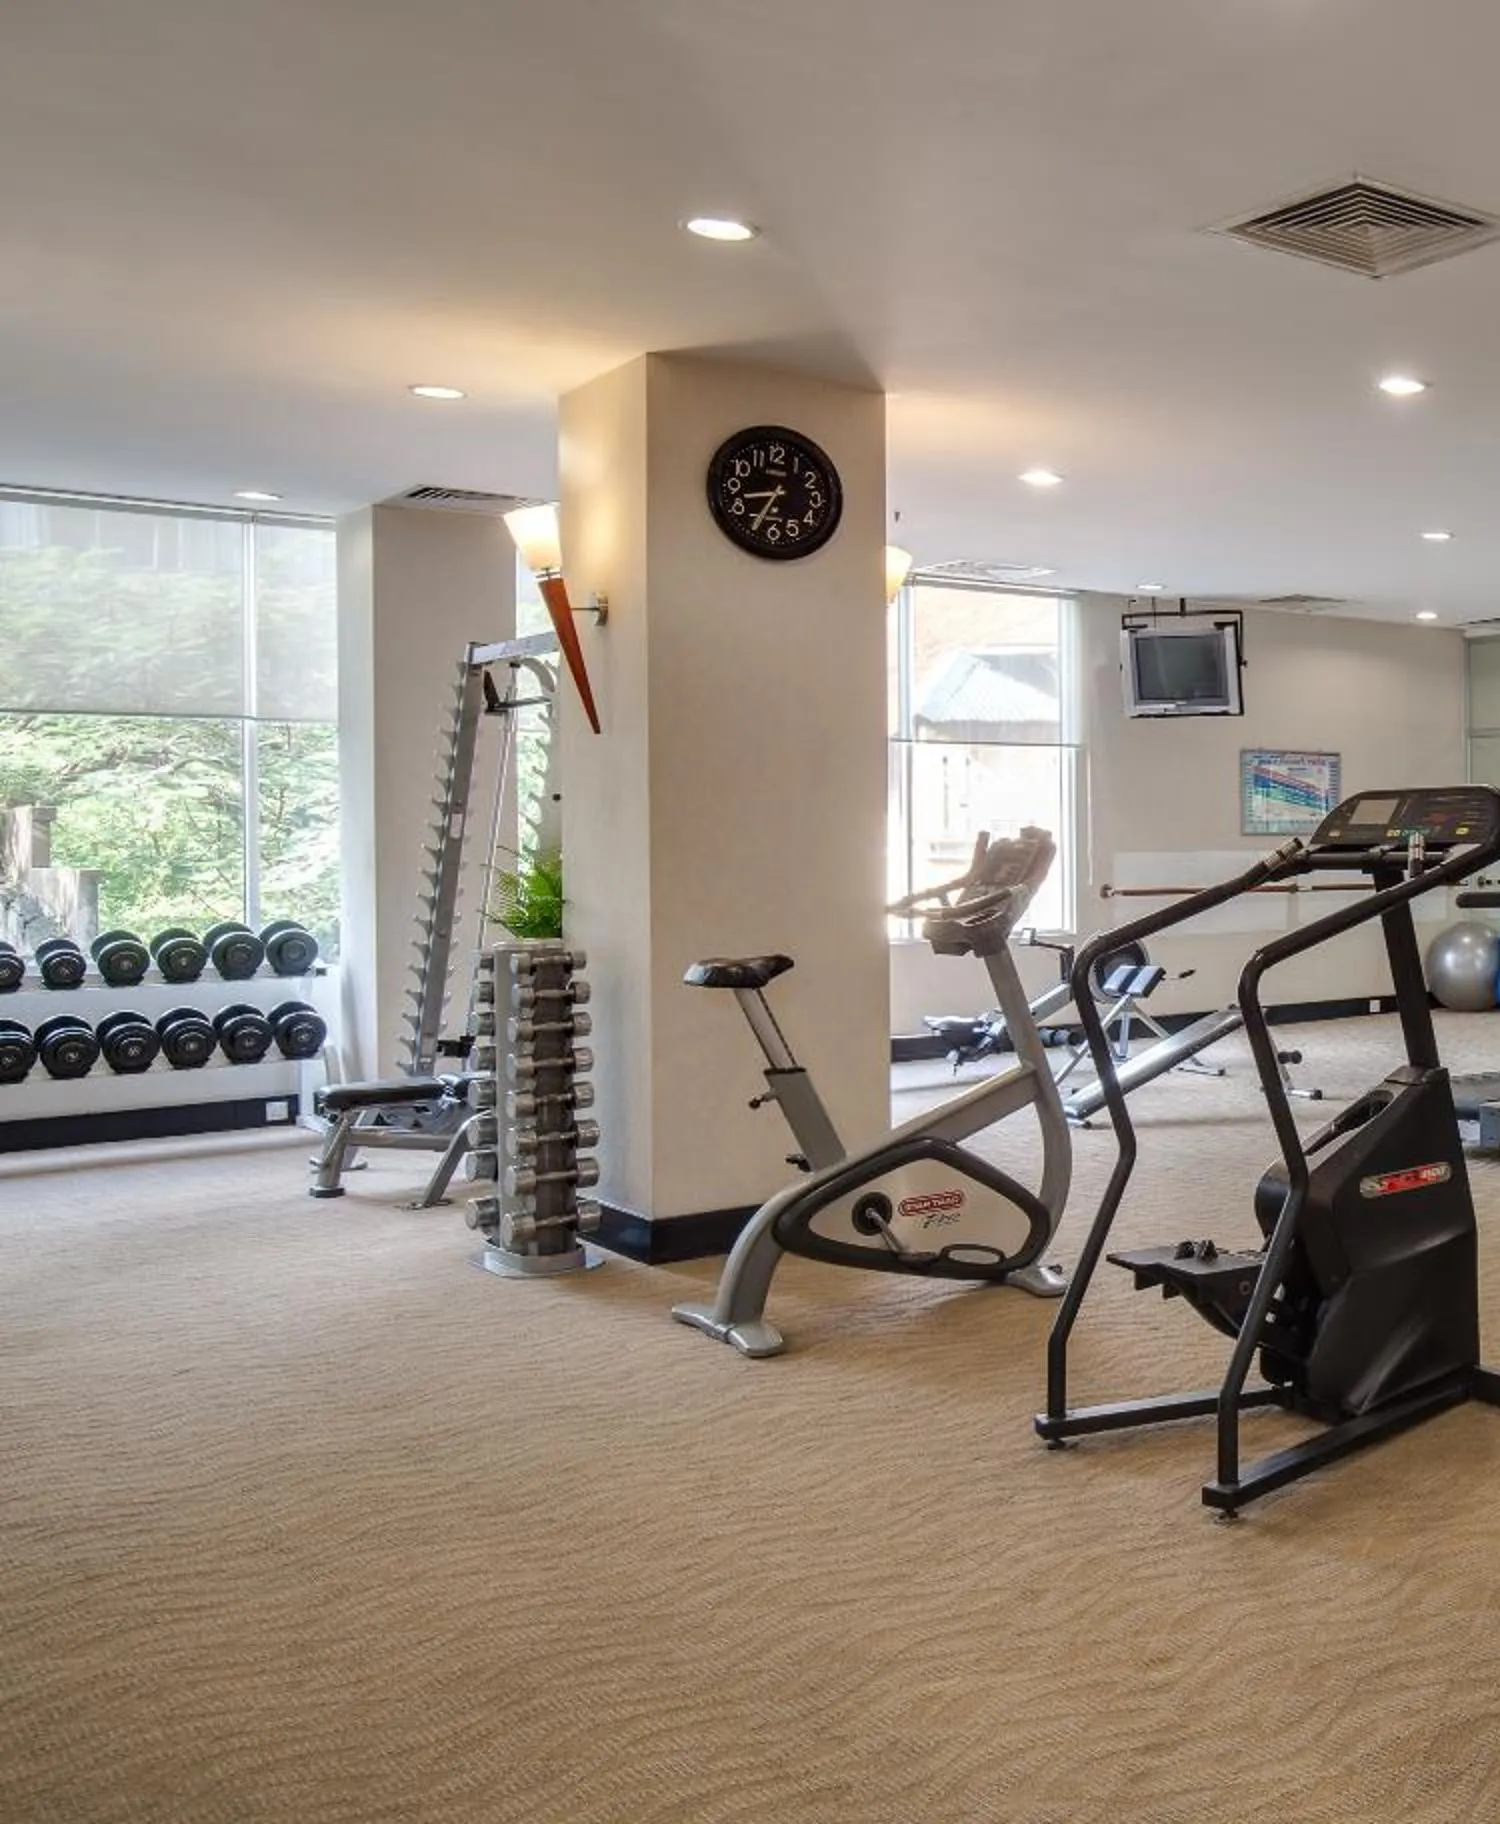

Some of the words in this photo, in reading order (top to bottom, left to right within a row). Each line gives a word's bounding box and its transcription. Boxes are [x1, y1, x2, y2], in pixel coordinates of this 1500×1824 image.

[753, 450, 765, 468] 11
[769, 445, 785, 465] 12
[734, 459, 751, 477] 10
[727, 477, 741, 494] 9
[804, 471, 817, 489] 2
[732, 498, 745, 515] 8
[803, 510, 814, 525] 4
[767, 523, 780, 541] 6
[786, 520, 799, 537] 5
